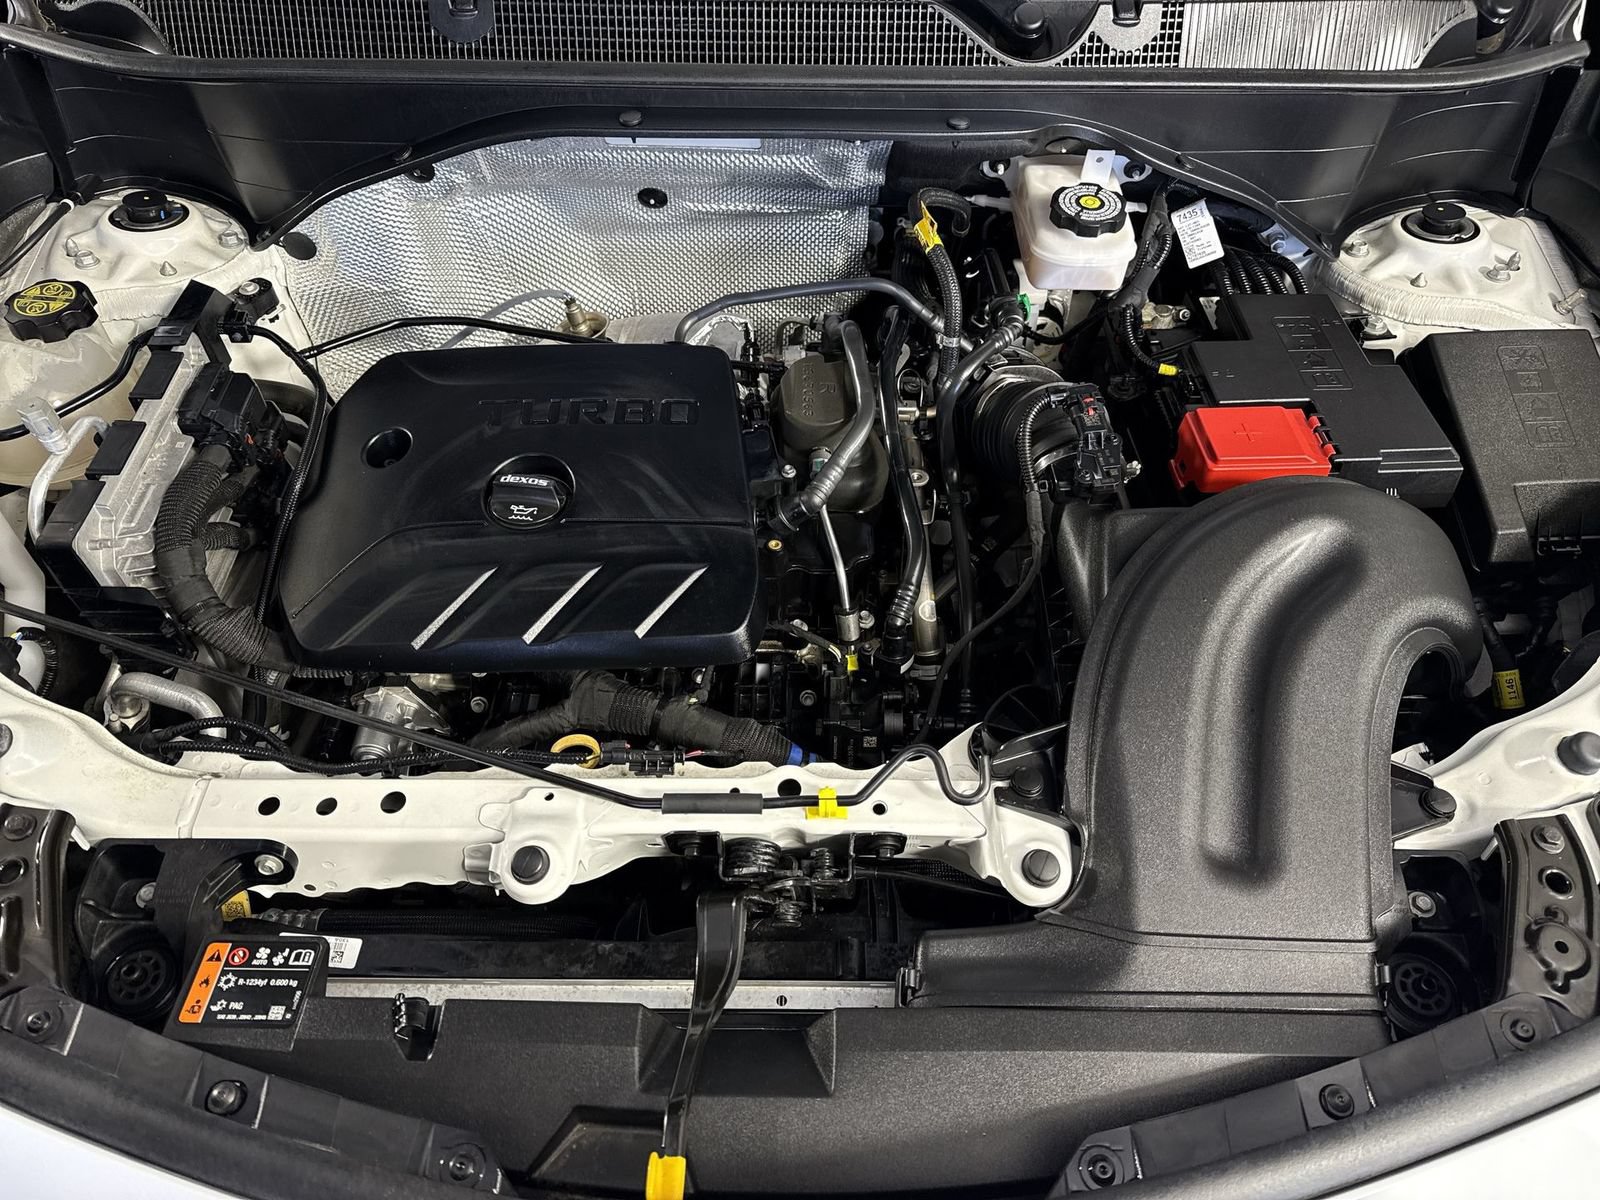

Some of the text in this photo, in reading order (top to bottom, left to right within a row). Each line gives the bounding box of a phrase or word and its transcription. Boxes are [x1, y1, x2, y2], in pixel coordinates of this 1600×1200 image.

[1176, 208, 1198, 222] 7435
[479, 398, 699, 425] TURBO
[500, 474, 550, 487] dexos
[1505, 678, 1517, 700] 1146
[238, 978, 268, 987] R-1234yf
[289, 979, 298, 988] kg
[228, 1001, 244, 1010] PAG
